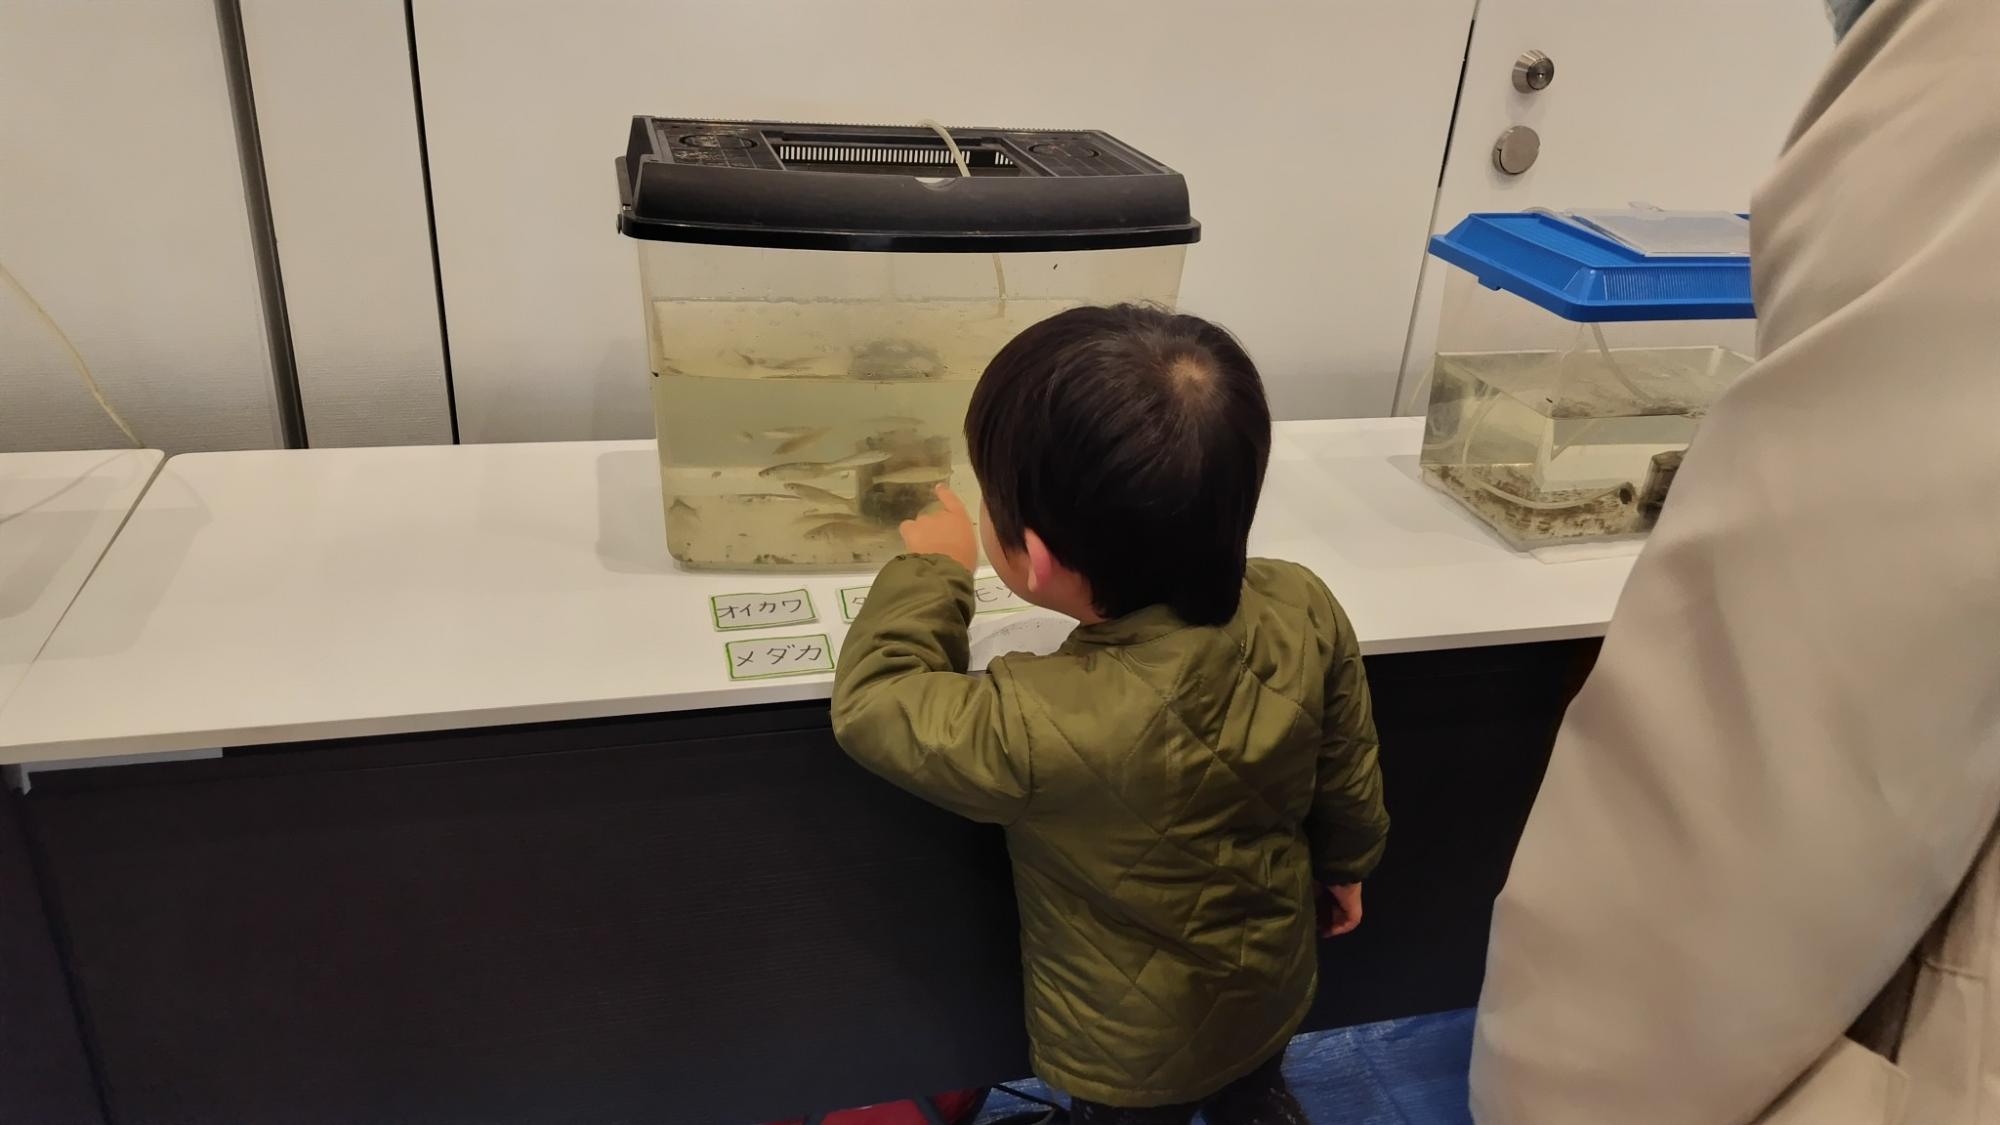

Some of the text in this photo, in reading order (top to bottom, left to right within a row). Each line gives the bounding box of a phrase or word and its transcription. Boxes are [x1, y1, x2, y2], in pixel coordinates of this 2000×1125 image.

[716, 599, 802, 619] オイカワ
[736, 644, 822, 667] メダカ
